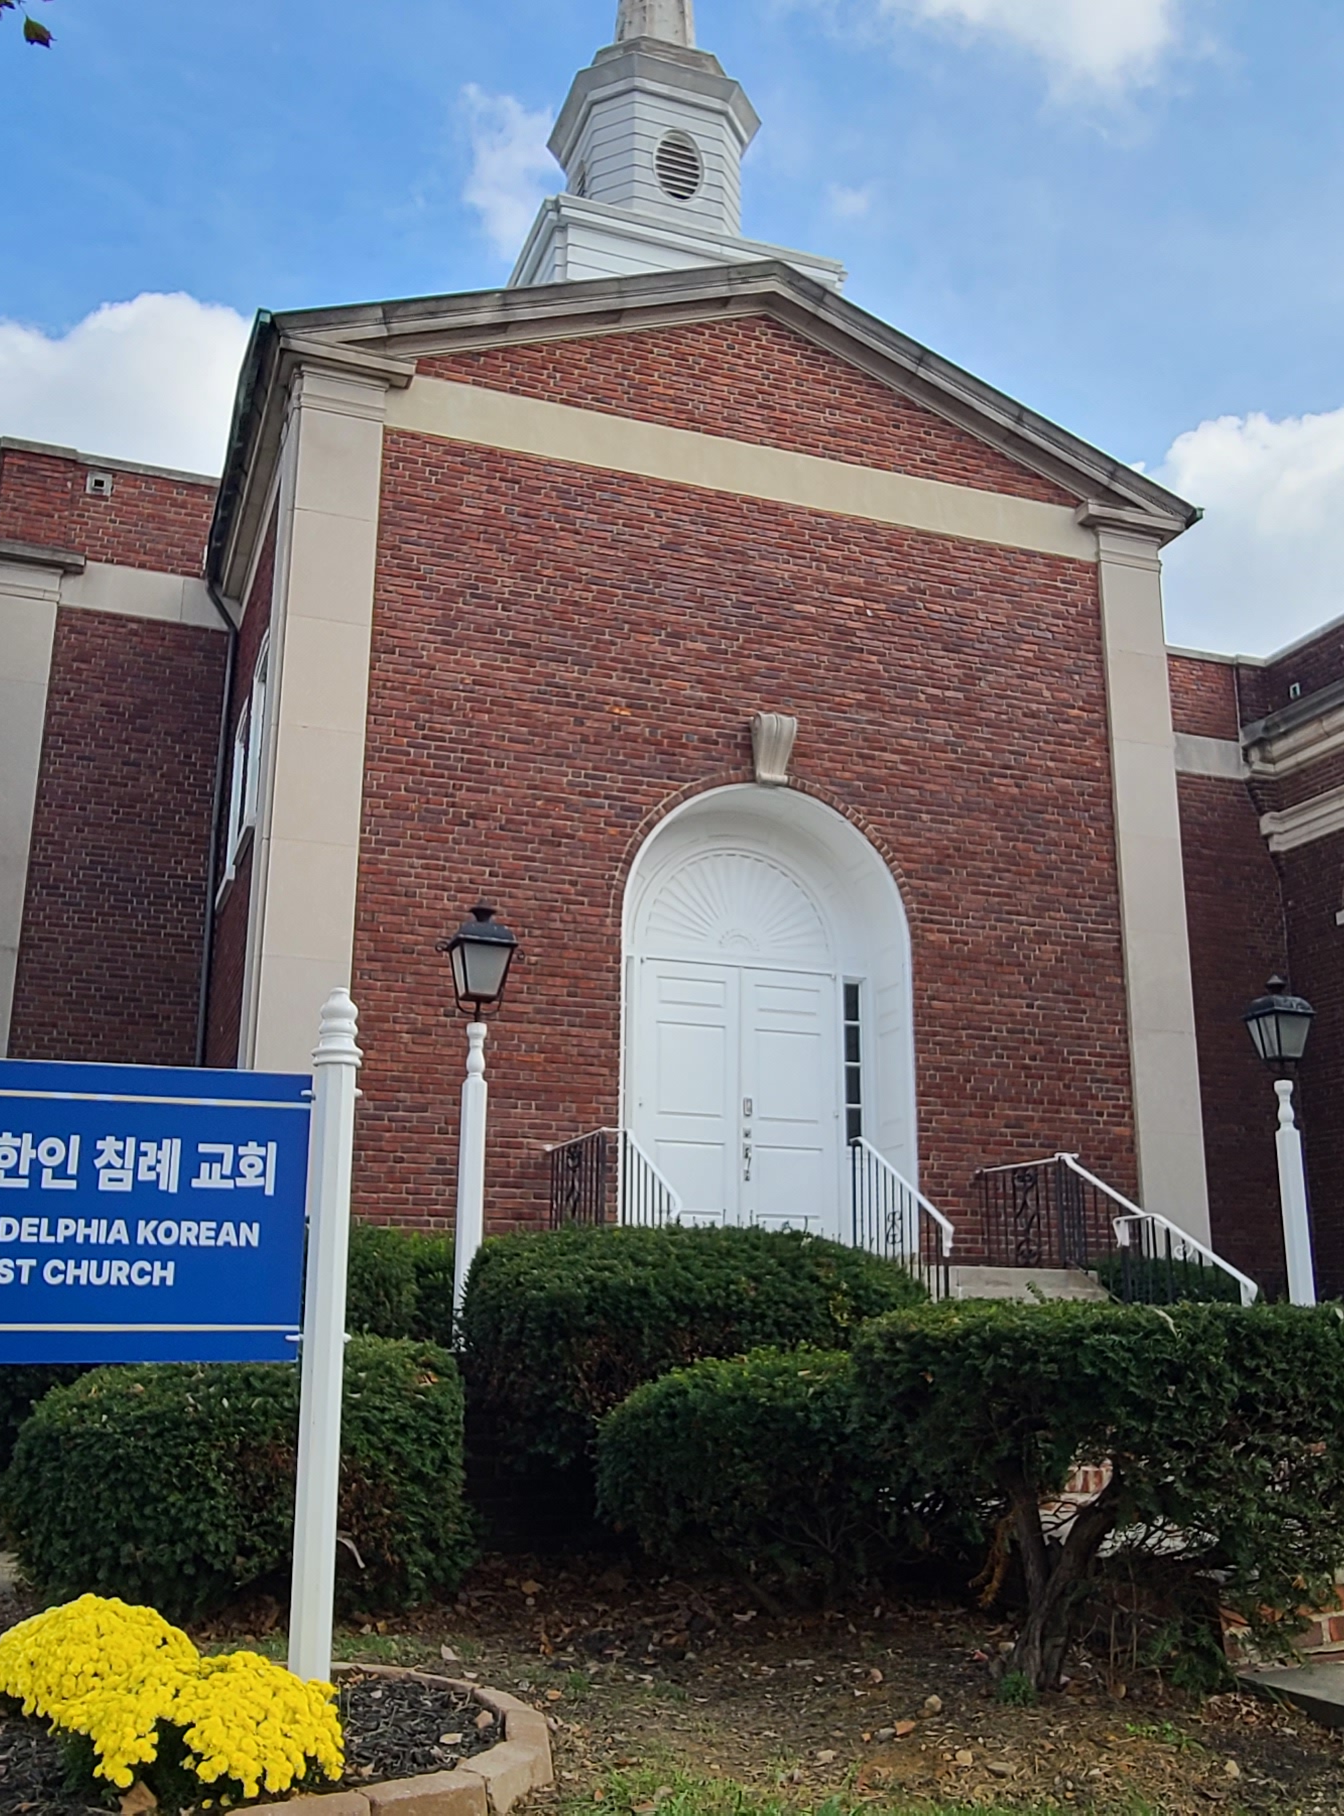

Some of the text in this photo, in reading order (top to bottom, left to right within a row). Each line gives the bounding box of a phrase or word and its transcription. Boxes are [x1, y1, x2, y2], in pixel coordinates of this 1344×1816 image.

[92, 1135, 182, 1193] 침례
[190, 1141, 278, 1196] 교회
[136, 1220, 260, 1247] KOREAN
[43, 1259, 175, 1286] CHURCH
